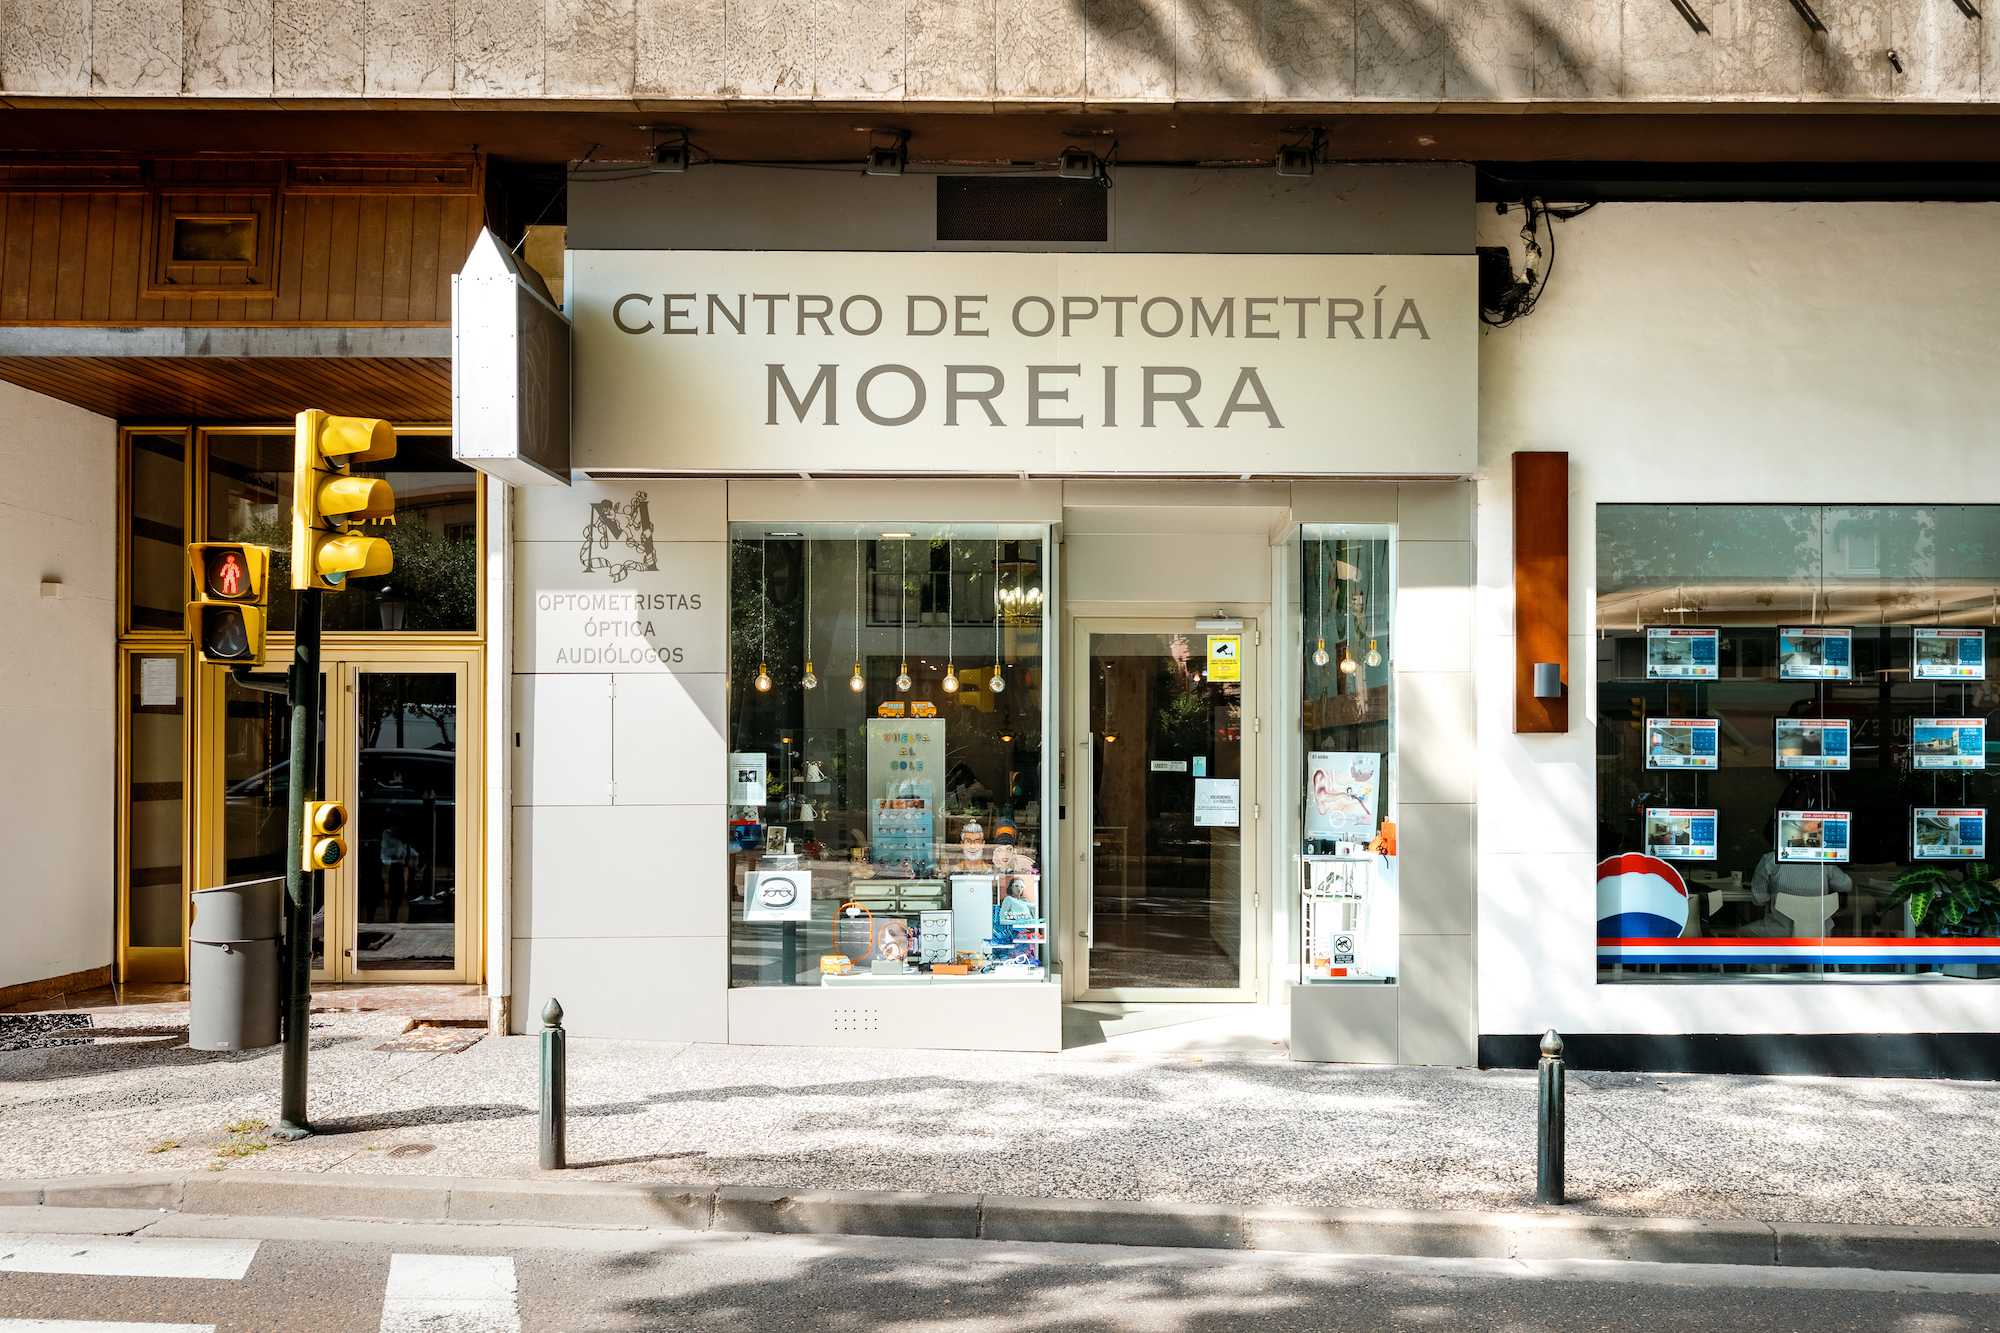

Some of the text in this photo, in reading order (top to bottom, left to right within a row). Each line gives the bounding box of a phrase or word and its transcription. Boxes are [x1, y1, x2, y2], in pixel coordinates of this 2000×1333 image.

[613, 284, 1431, 340] CENTRO DE OPTOMETRÍA
[764, 363, 1285, 429] MOREIRA
[538, 593, 702, 611] OPTOMETRISTAS
[584, 616, 656, 637] ÓPTICA
[556, 643, 684, 664] AUDIÓLOGOS
